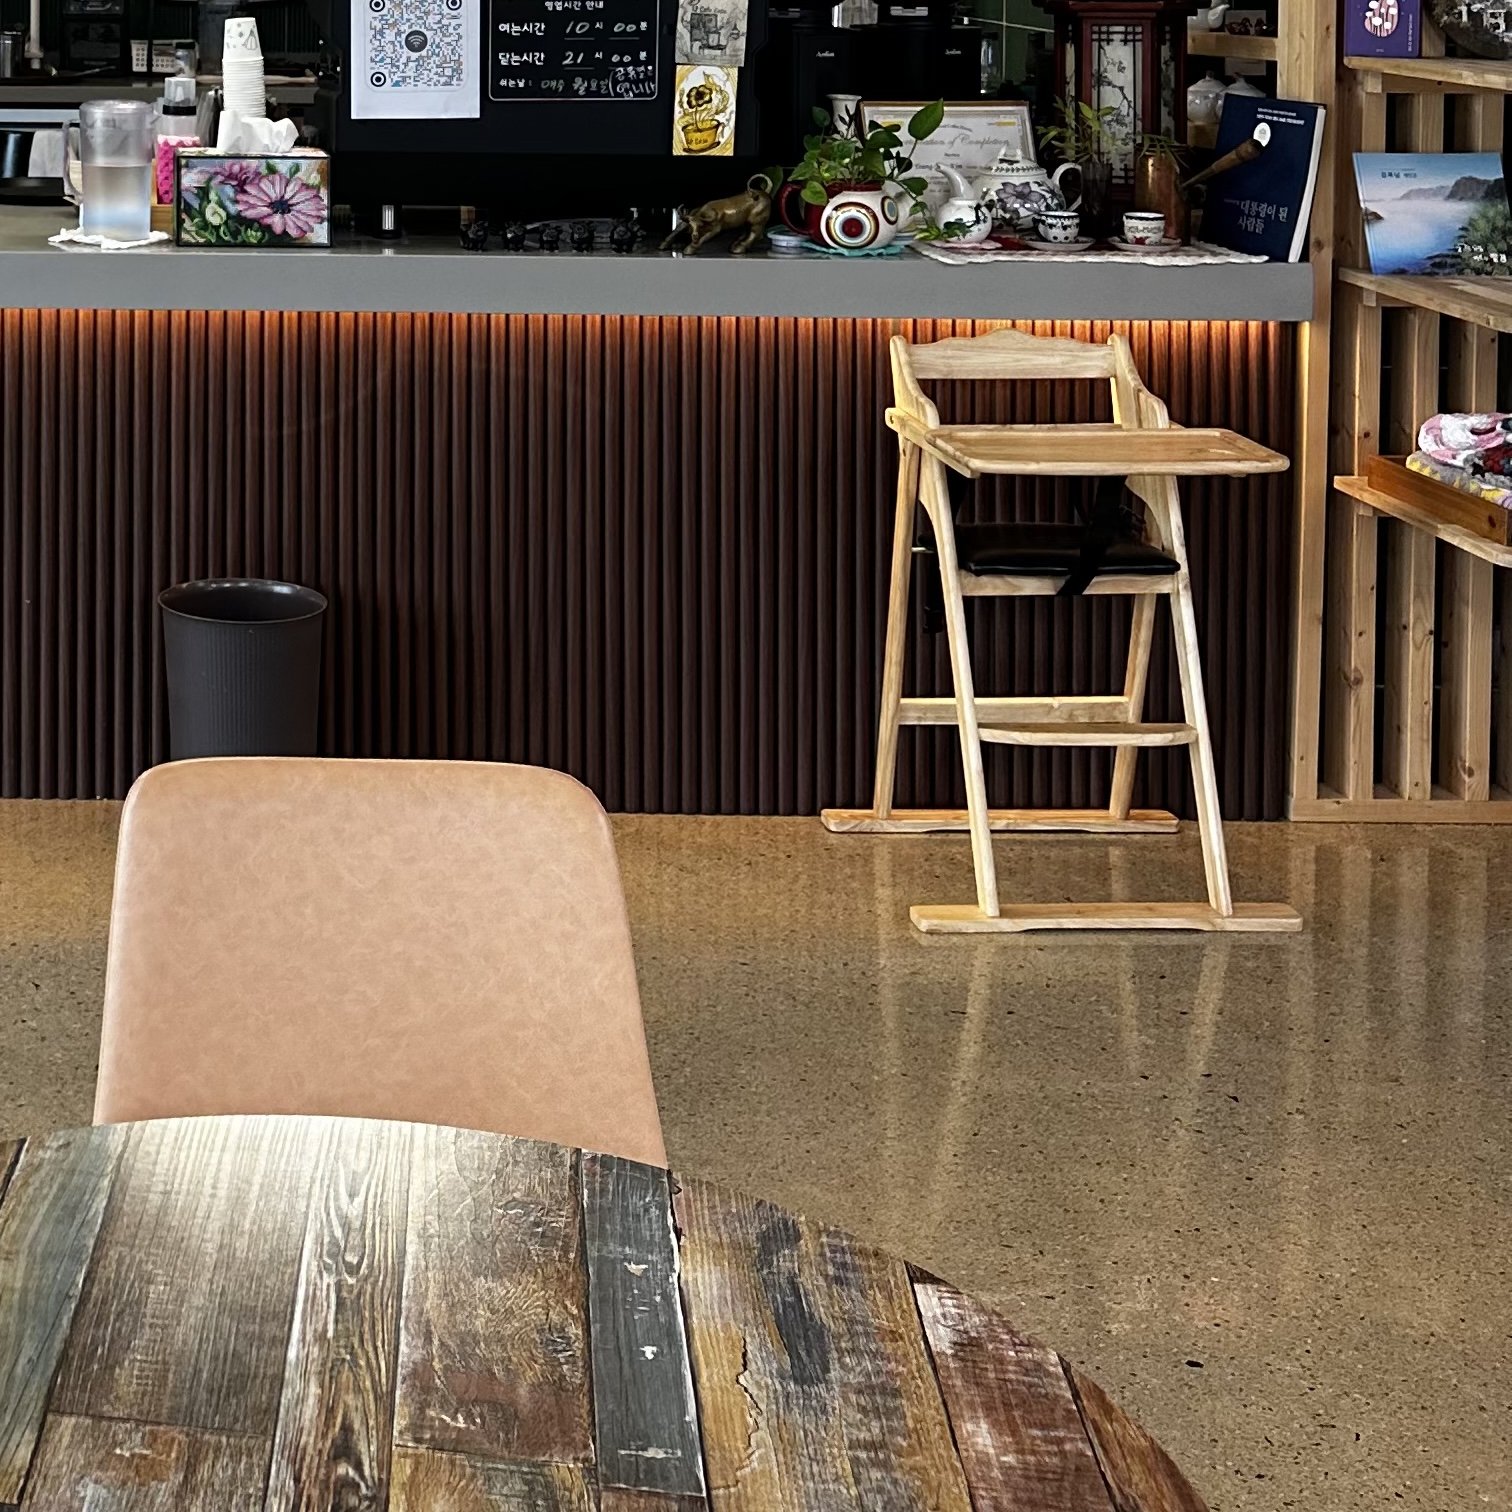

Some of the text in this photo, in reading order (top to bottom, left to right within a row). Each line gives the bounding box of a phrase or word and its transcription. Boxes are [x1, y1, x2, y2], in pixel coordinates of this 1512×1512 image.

[544, 0, 604, 11] 영업시간 안내
[498, 20, 648, 36] 여는시간 10 시 00 분
[498, 51, 647, 66] 닫는시간 21 시 00 분
[499, 76, 608, 95] 쉬는날 매주 월요일
